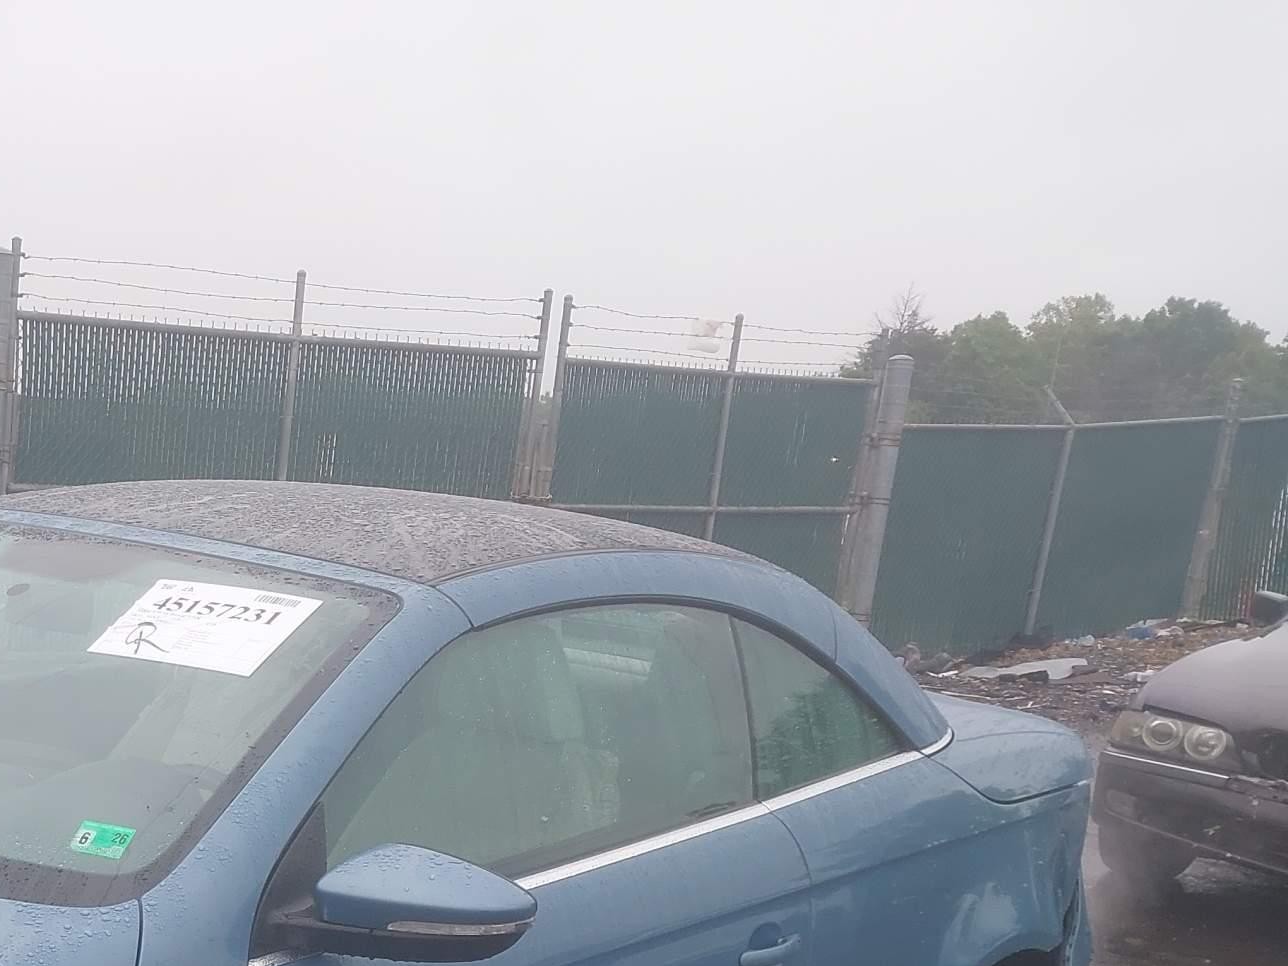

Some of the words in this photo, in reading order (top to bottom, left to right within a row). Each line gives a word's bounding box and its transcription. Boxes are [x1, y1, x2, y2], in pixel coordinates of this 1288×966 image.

[153, 597, 282, 625] 45157231
[78, 832, 91, 845] 6
[112, 832, 130, 845] 26
